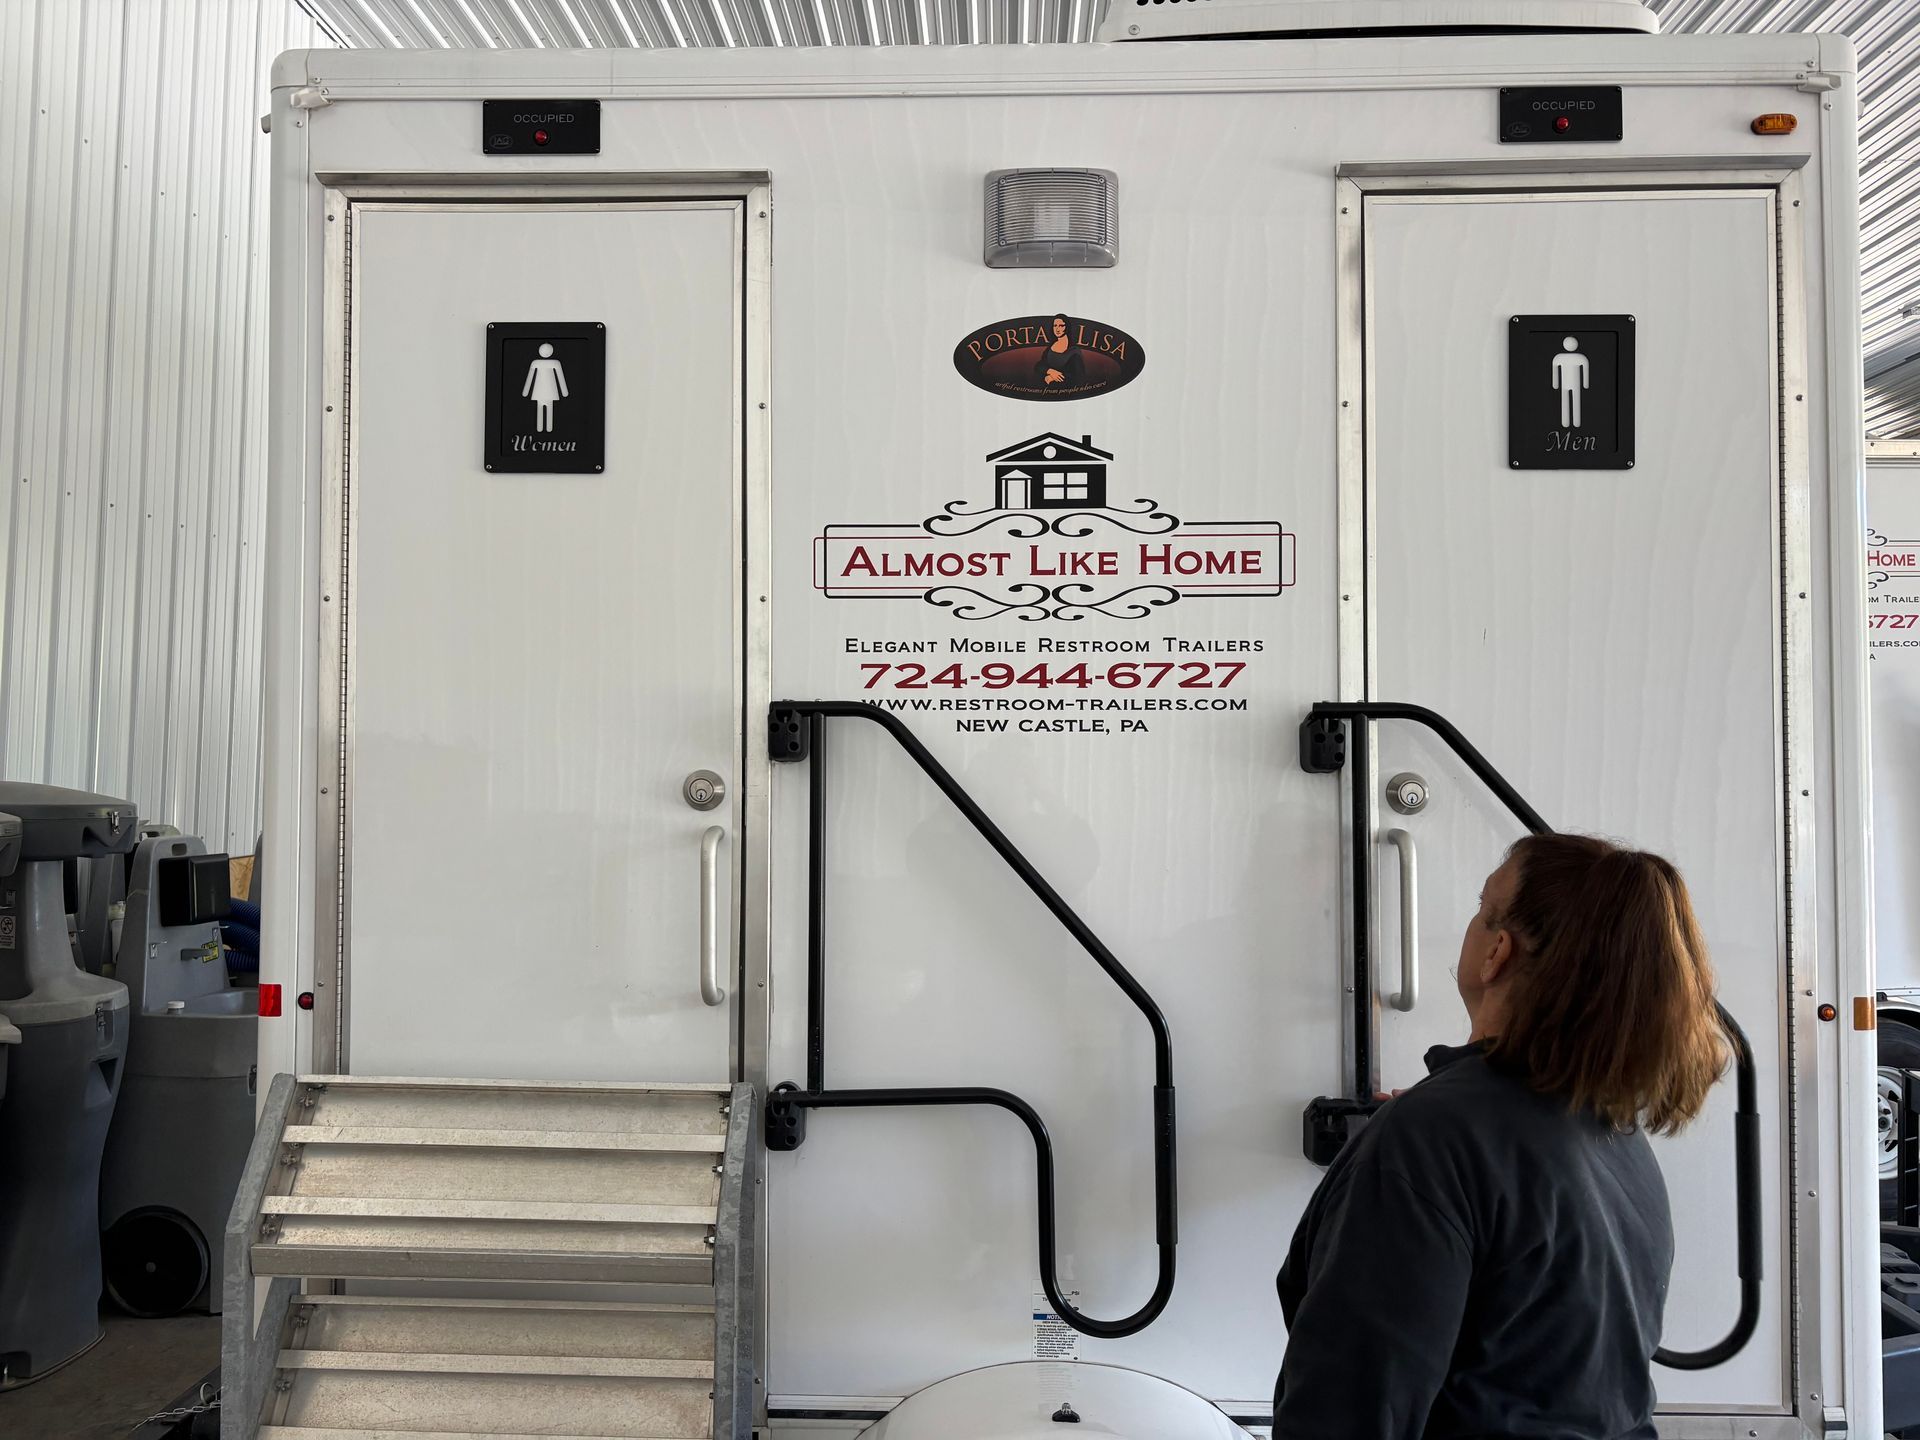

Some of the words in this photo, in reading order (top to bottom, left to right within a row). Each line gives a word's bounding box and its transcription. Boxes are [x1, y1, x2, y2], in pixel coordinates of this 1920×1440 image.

[1532, 101, 1596, 111] OCCUPIED
[513, 114, 575, 123] OCCUPIED
[967, 326, 1050, 362] PORTA
[1078, 325, 1127, 361] LISA
[511, 435, 577, 452] Women
[1545, 431, 1596, 452] Men
[841, 546, 1011, 577] ALMOST
[1029, 545, 1119, 576] LIKE
[1139, 544, 1262, 575] HOME
[1884, 594, 1920, 603] TRAILE
[845, 637, 938, 653] ELEGANT
[949, 637, 1026, 653] MOBILE
[1038, 637, 1150, 653] RESTROOM
[1163, 637, 1264, 653] TRAILERS
[860, 661, 1247, 690] 724-944-6727
[956, 719, 1010, 733] NEW
[1018, 719, 1111, 736] CASTLE,
[1120, 719, 1149, 733] PA
